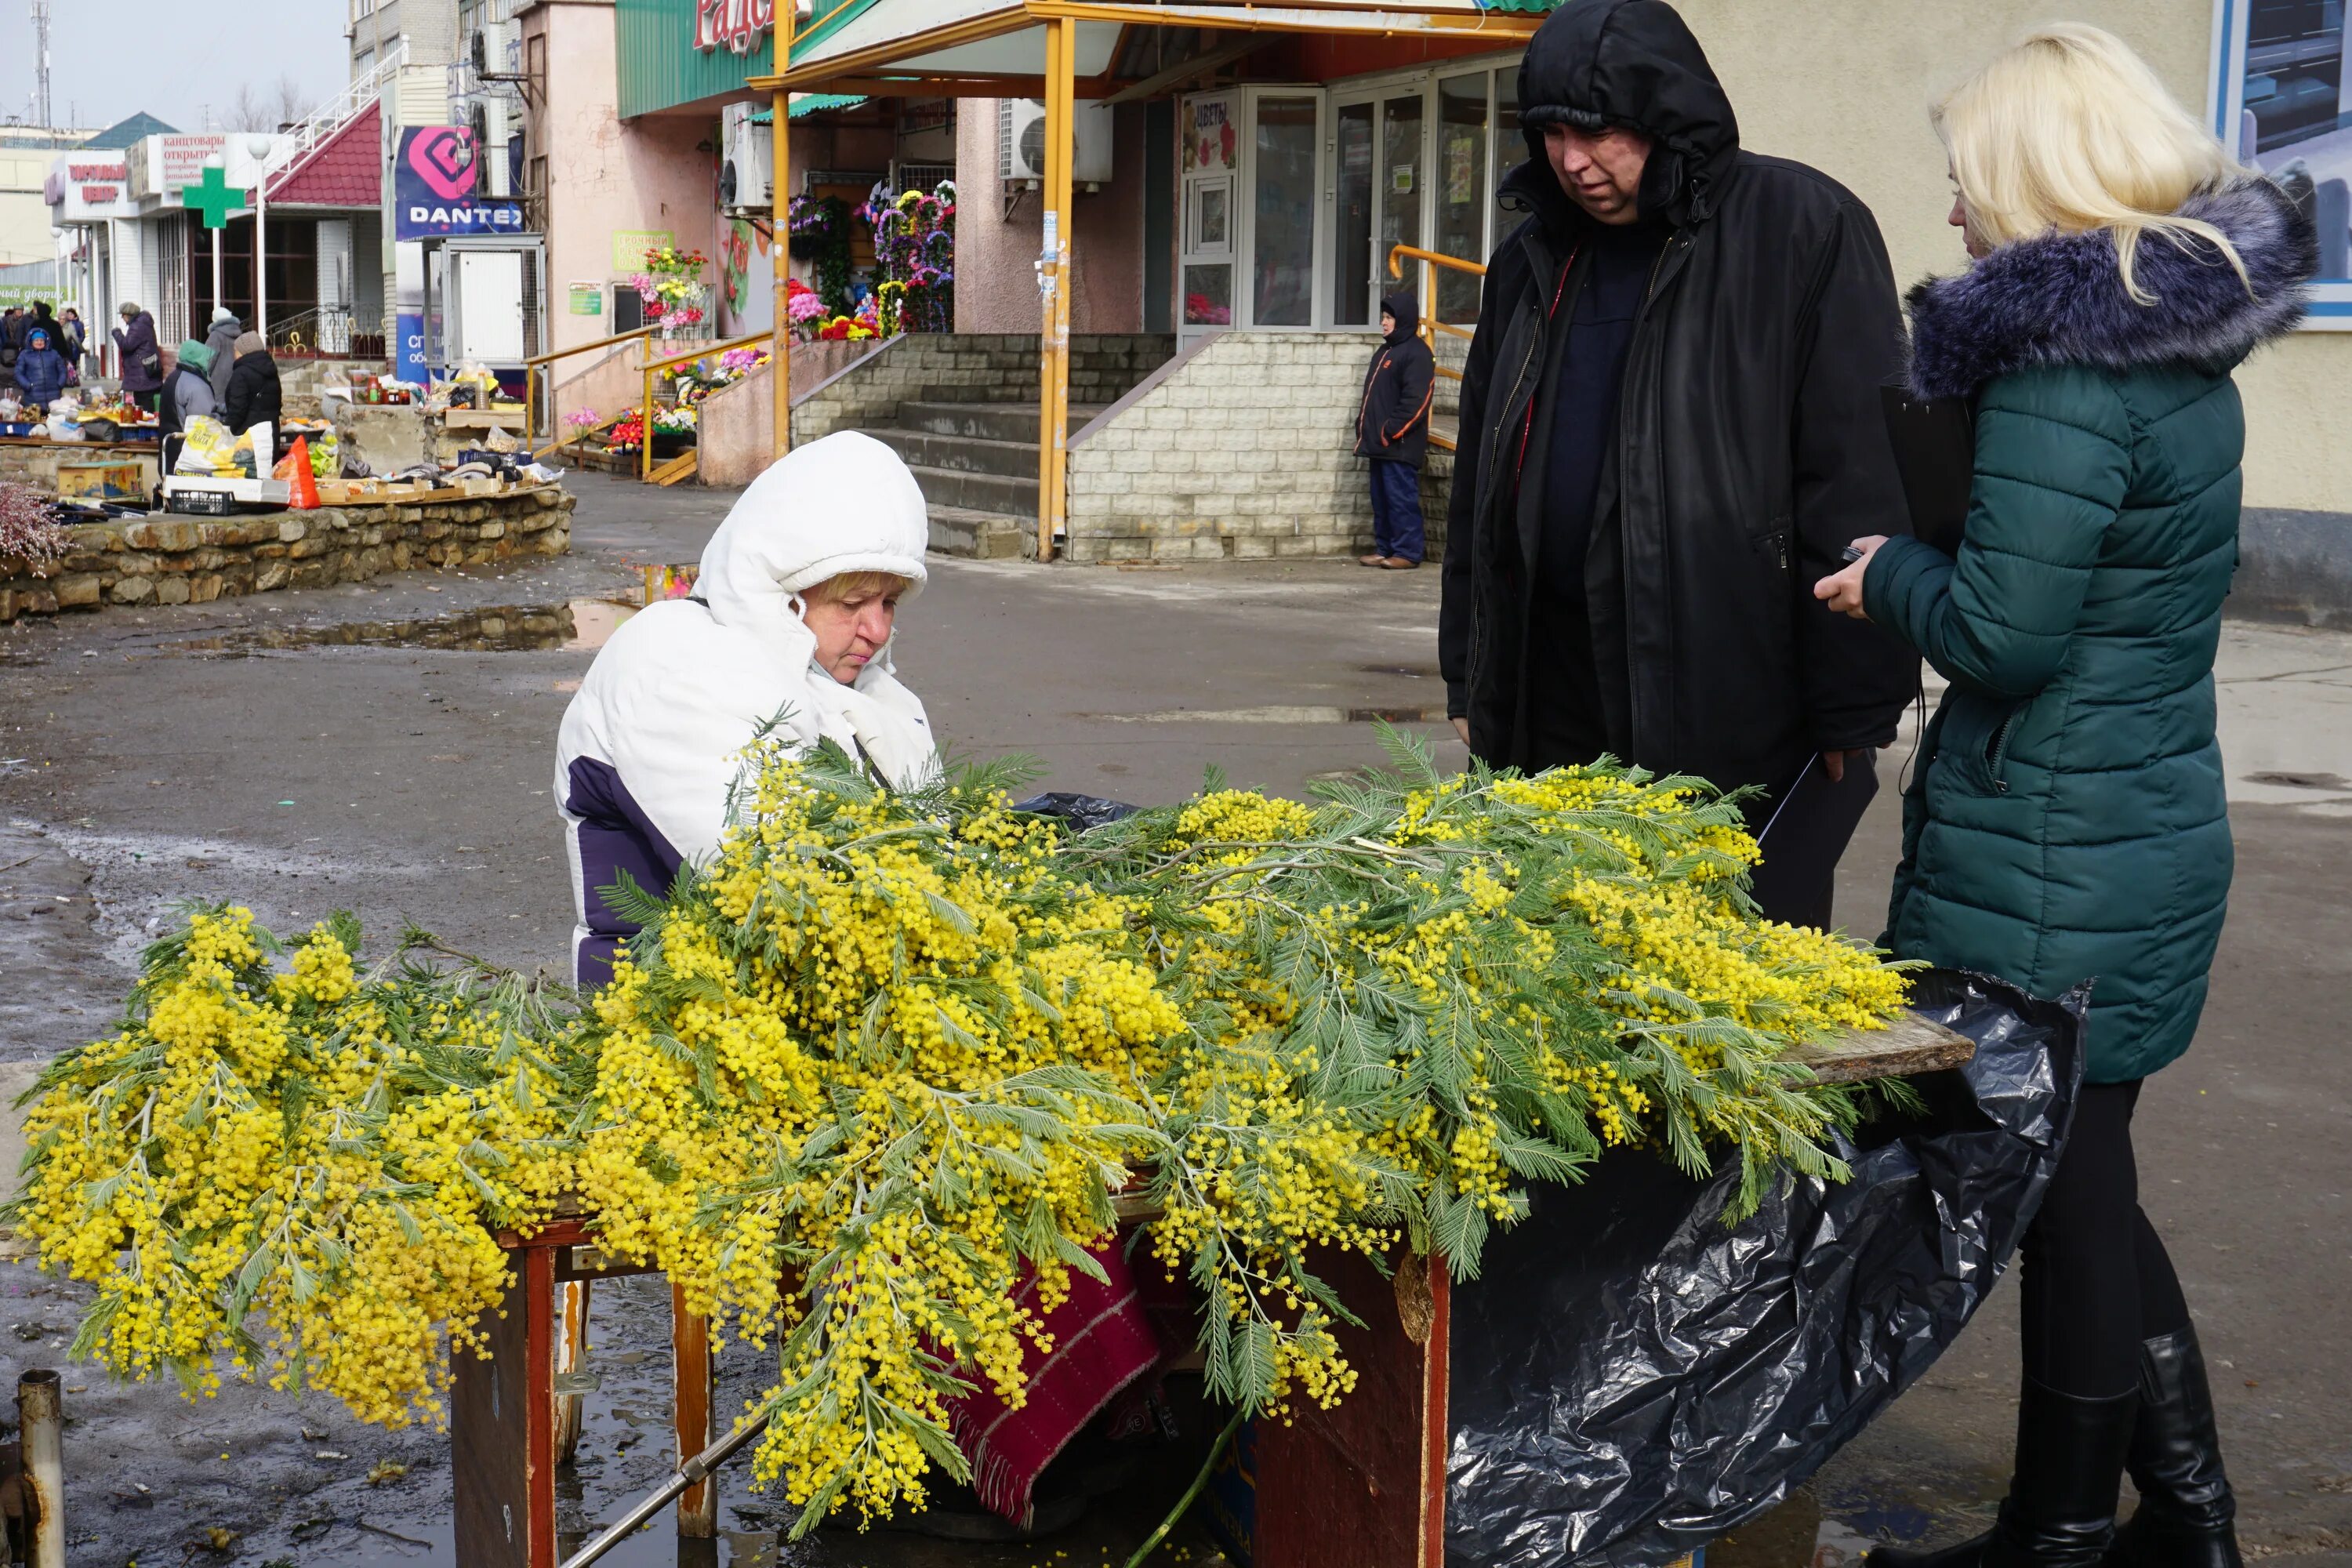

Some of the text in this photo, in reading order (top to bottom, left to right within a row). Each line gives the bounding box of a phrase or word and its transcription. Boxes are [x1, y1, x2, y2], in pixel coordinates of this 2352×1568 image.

[1196, 102, 1227, 132] ЦВЕТЫ
[164, 136, 225, 149] канцтовары
[164, 151, 219, 163] открытк
[82, 185, 118, 205] ЦЕНТР
[619, 234, 668, 245] СРОЧНЫЙ
